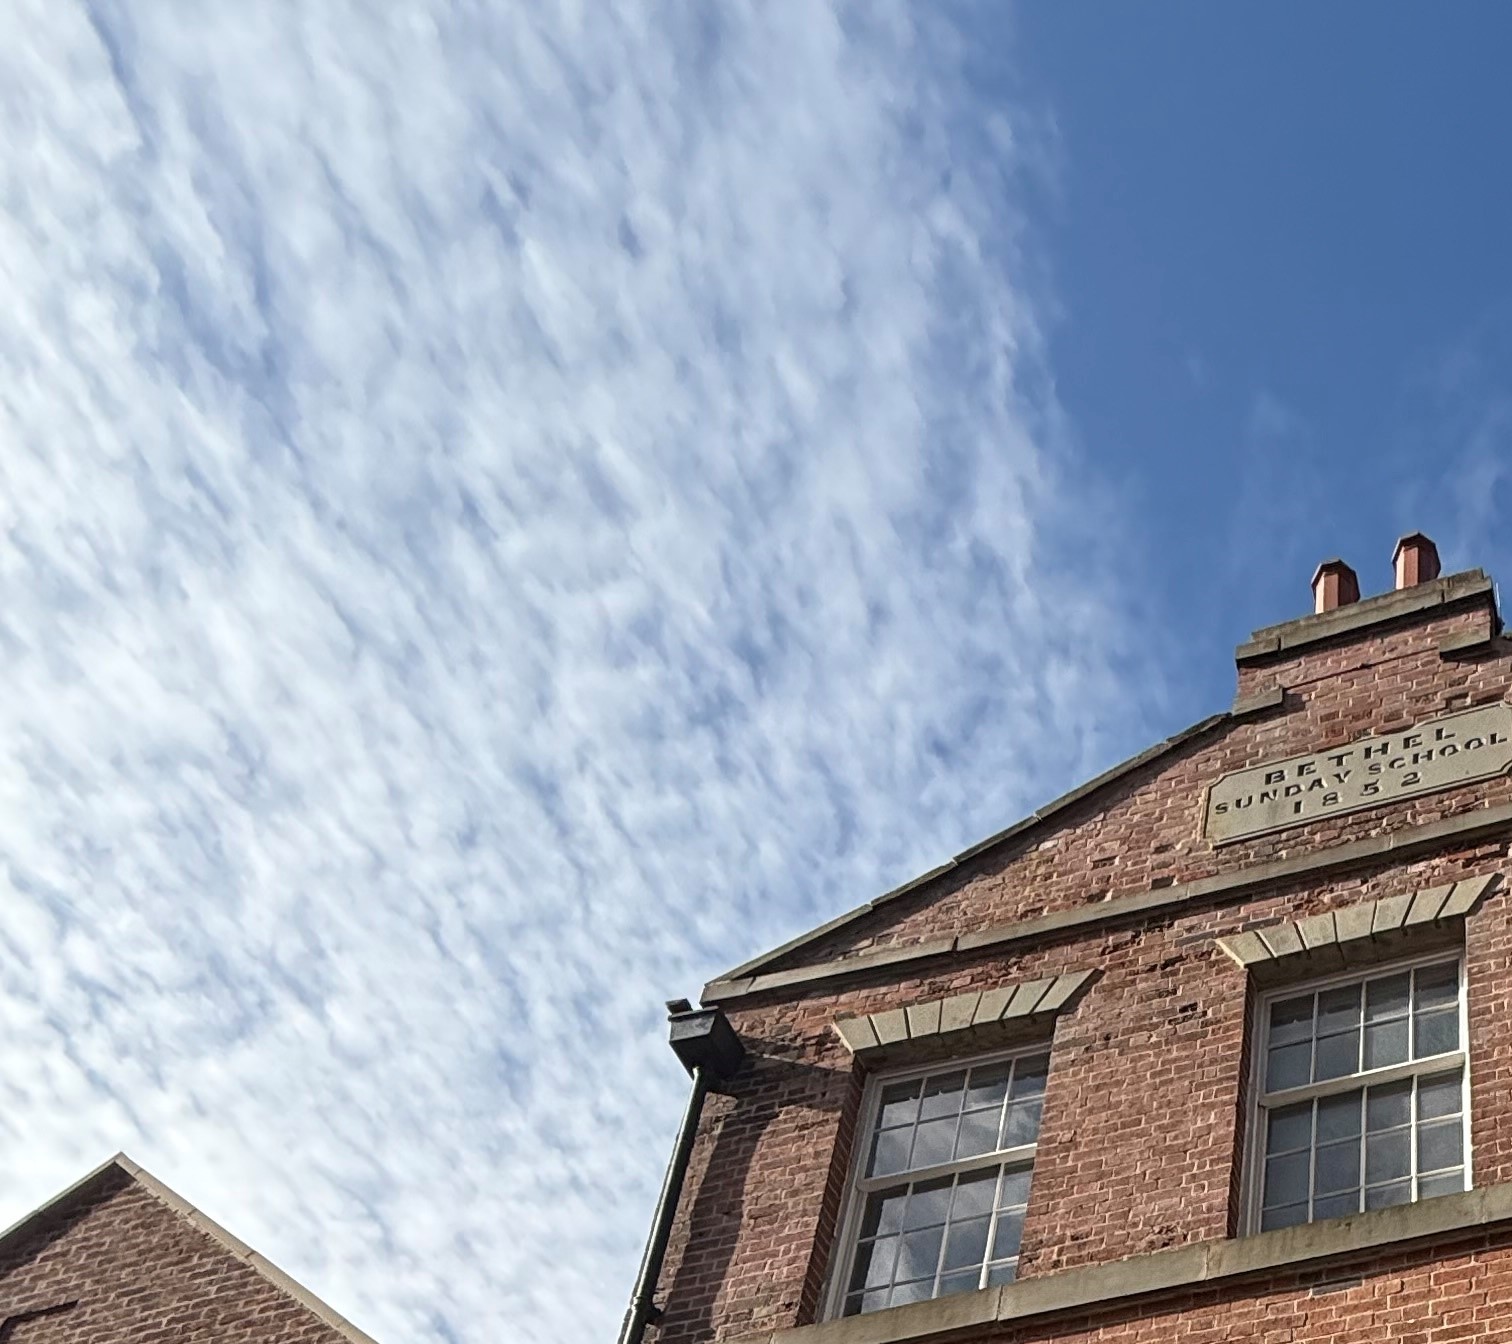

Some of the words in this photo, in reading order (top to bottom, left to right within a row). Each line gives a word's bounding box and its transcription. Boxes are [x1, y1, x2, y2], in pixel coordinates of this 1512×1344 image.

[1215, 770, 1351, 815] SUNDAY
[1368, 732, 1508, 776] SCHOOL
[1265, 727, 1456, 786] BETHEL
[1293, 771, 1422, 815] 1852
